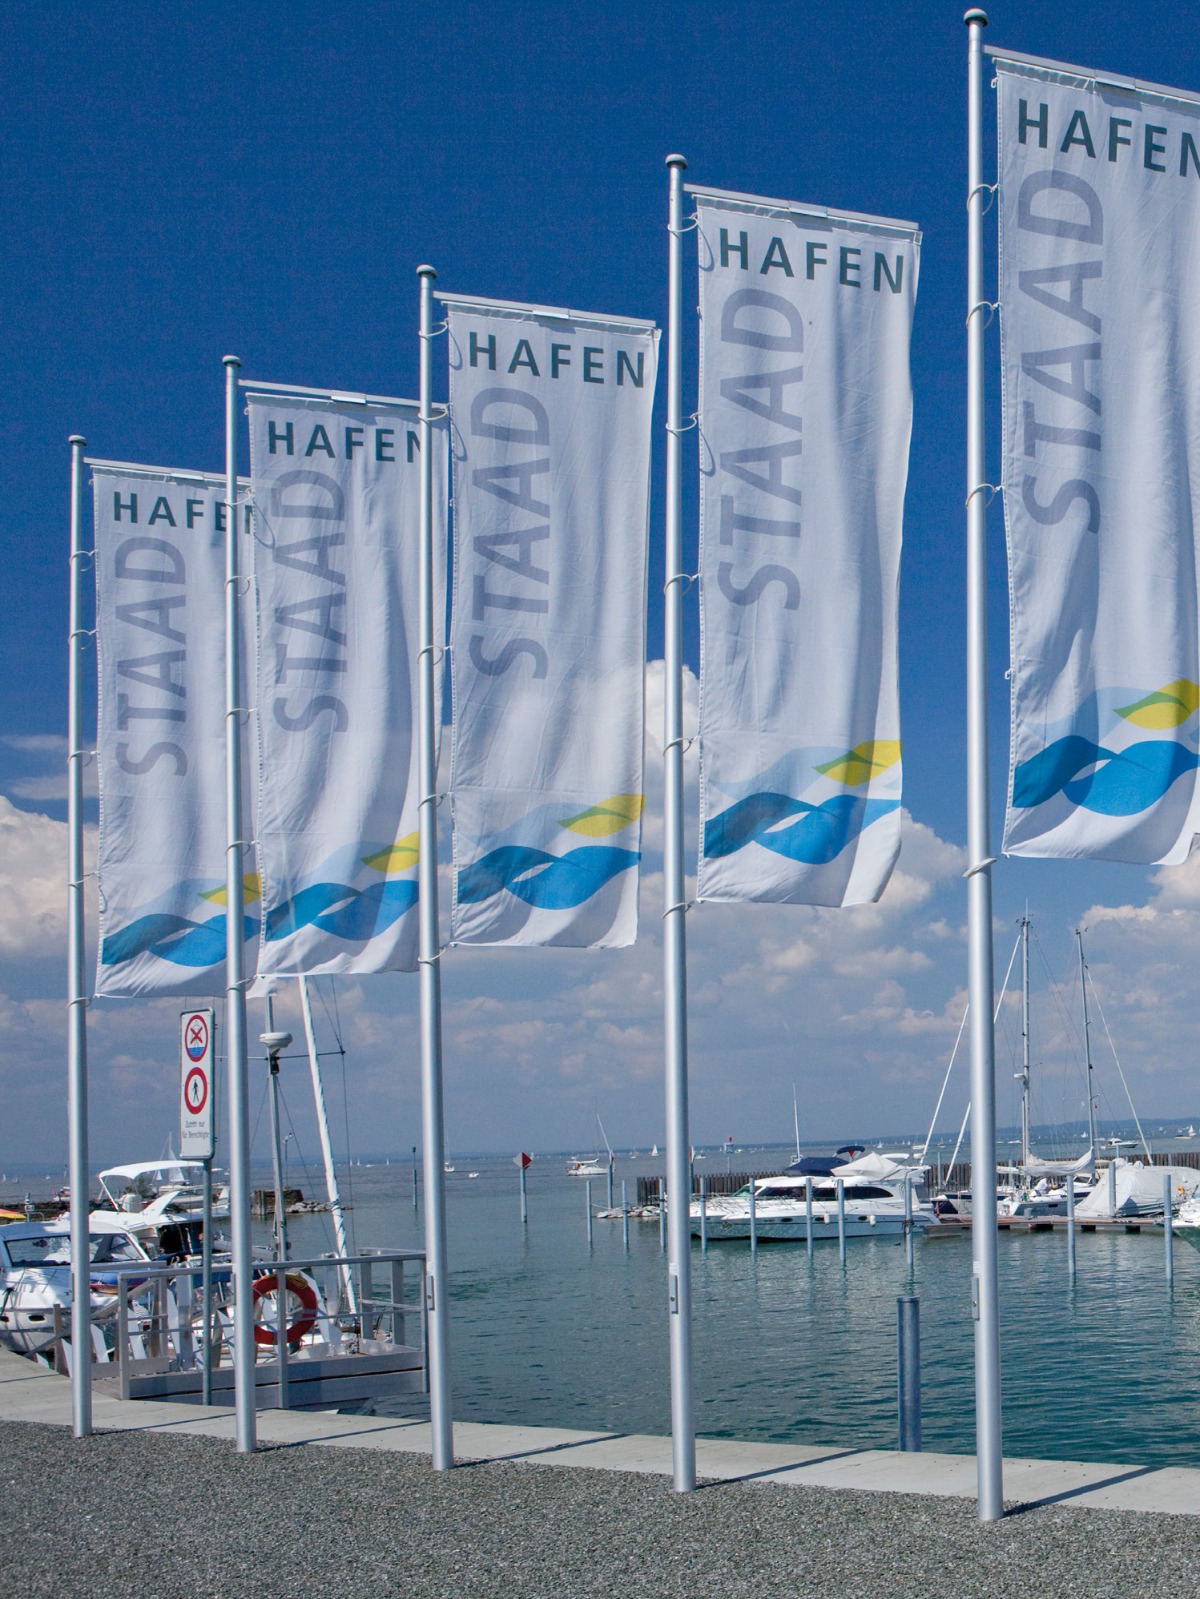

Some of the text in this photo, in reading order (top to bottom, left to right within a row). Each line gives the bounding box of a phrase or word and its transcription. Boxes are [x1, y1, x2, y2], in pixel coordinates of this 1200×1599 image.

[468, 331, 645, 389] HAFEN
[719, 228, 904, 294] HAFEN
[1017, 169, 1104, 535] STAAD
[468, 387, 551, 680] STAAD
[717, 288, 804, 611] STAAD
[114, 536, 188, 777] STAAD
[270, 469, 349, 733] STAAD
